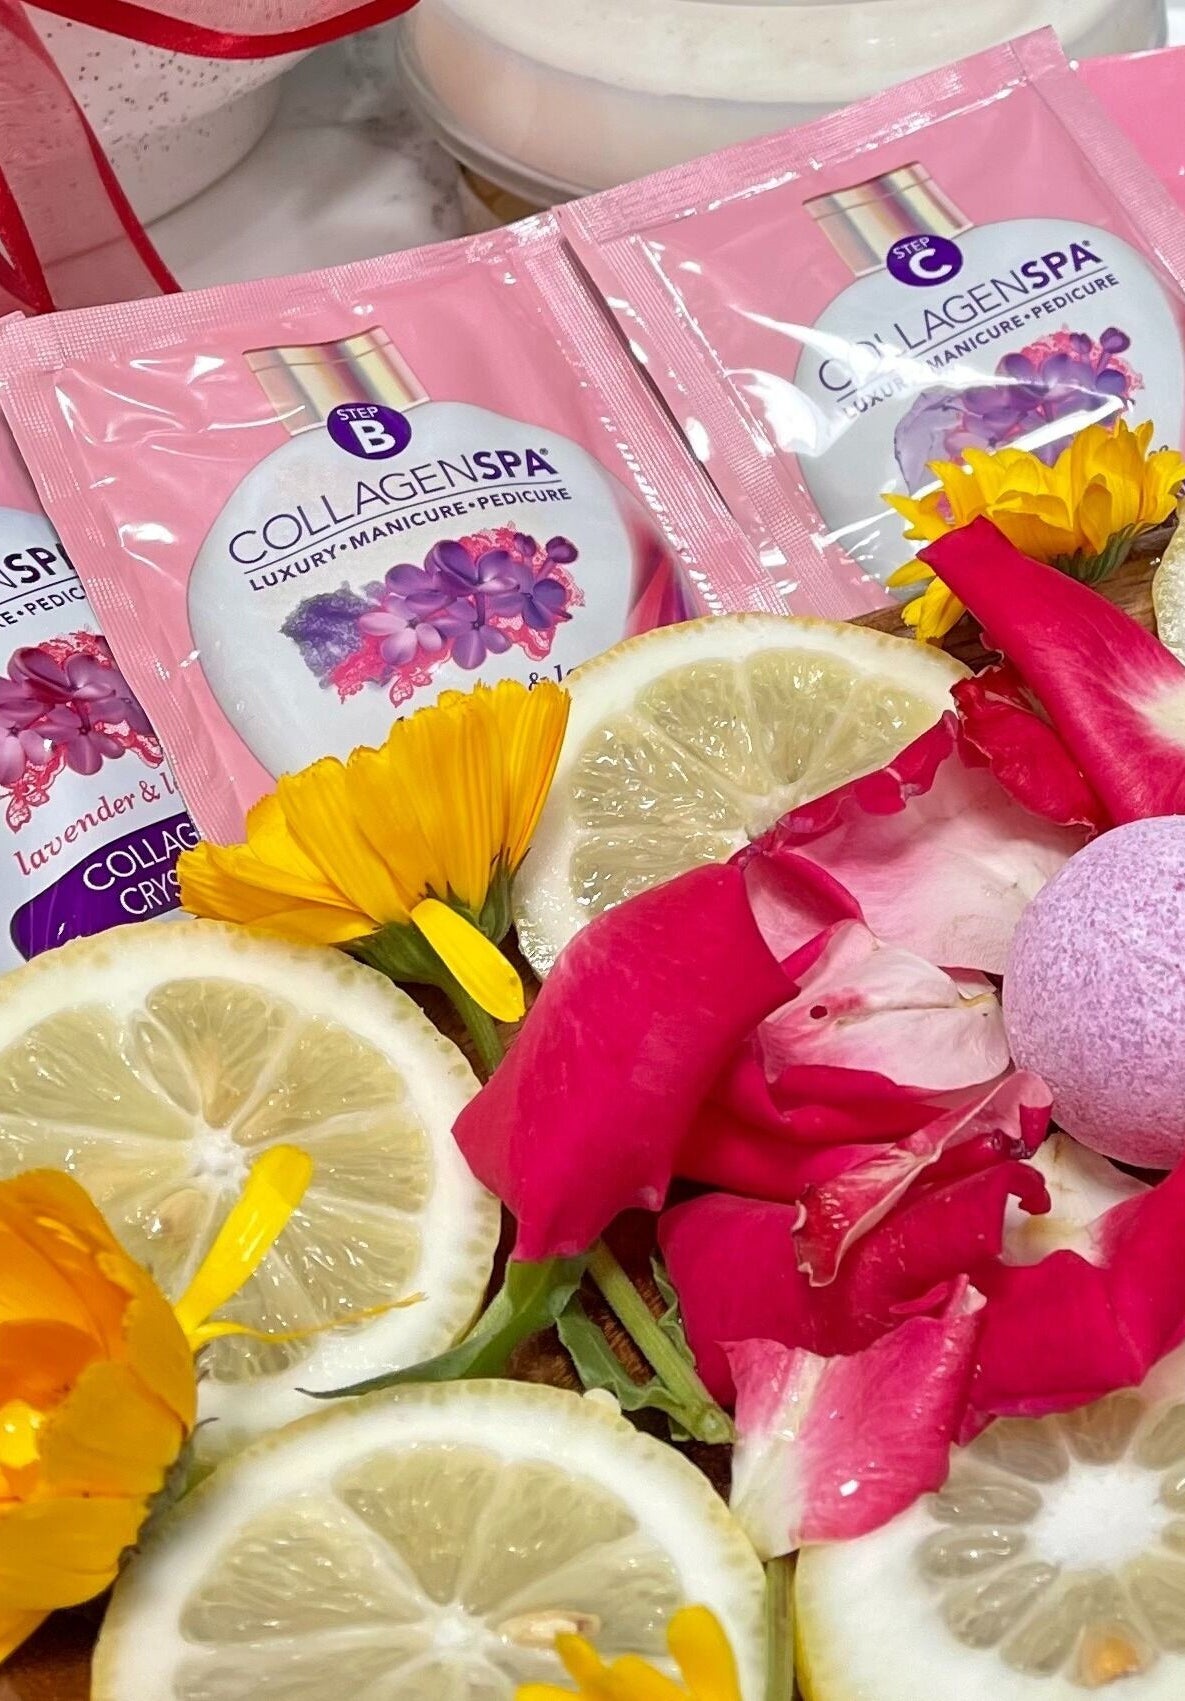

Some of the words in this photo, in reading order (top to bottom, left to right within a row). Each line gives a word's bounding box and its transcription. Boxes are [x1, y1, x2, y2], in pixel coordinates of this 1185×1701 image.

[892, 236, 930, 260] STEP
[908, 248, 953, 279] C
[336, 406, 378, 421] STEP
[348, 420, 396, 454] B
[13, 791, 136, 876] lavender
[138, 780, 161, 802] &
[82, 822, 201, 891] COLLAG
[119, 869, 181, 915] CRYS
